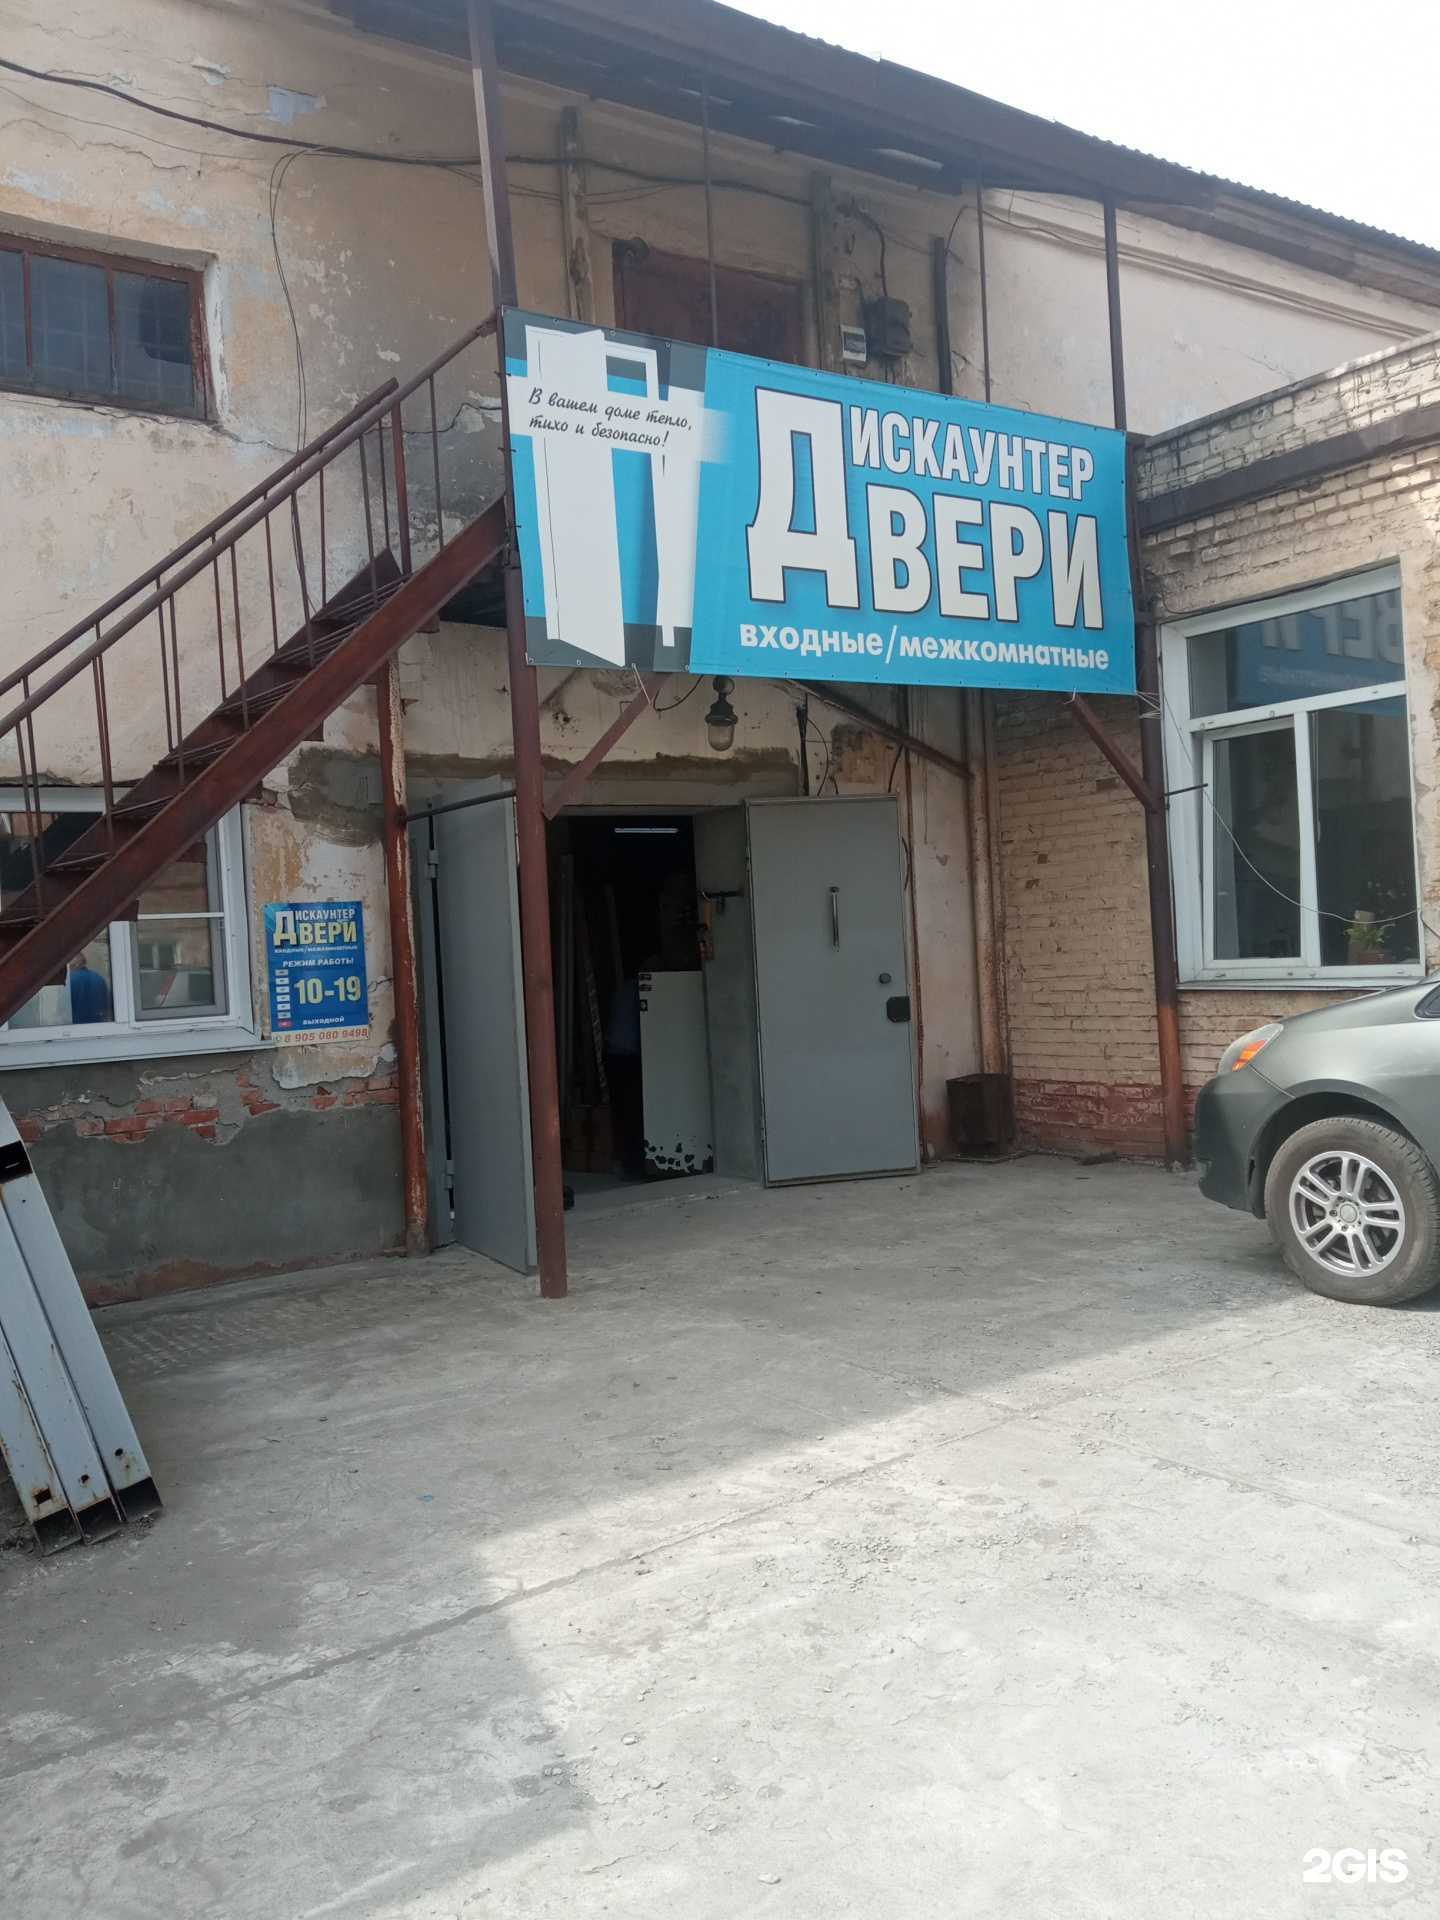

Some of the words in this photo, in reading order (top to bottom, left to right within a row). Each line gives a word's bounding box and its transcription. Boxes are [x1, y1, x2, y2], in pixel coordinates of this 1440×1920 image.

[528, 387, 543, 405] В
[548, 392, 598, 414] вашем
[604, 405, 641, 421] доме
[645, 410, 692, 431] тепло,
[529, 415, 569, 432] тихо
[575, 423, 585, 434] и
[591, 422, 669, 447] безопасно!
[282, 959, 316, 968] РЕЖИМ
[317, 957, 354, 966] РАБОТЫ
[294, 975, 362, 1005] 10-19
[295, 1032, 315, 1042] 905
